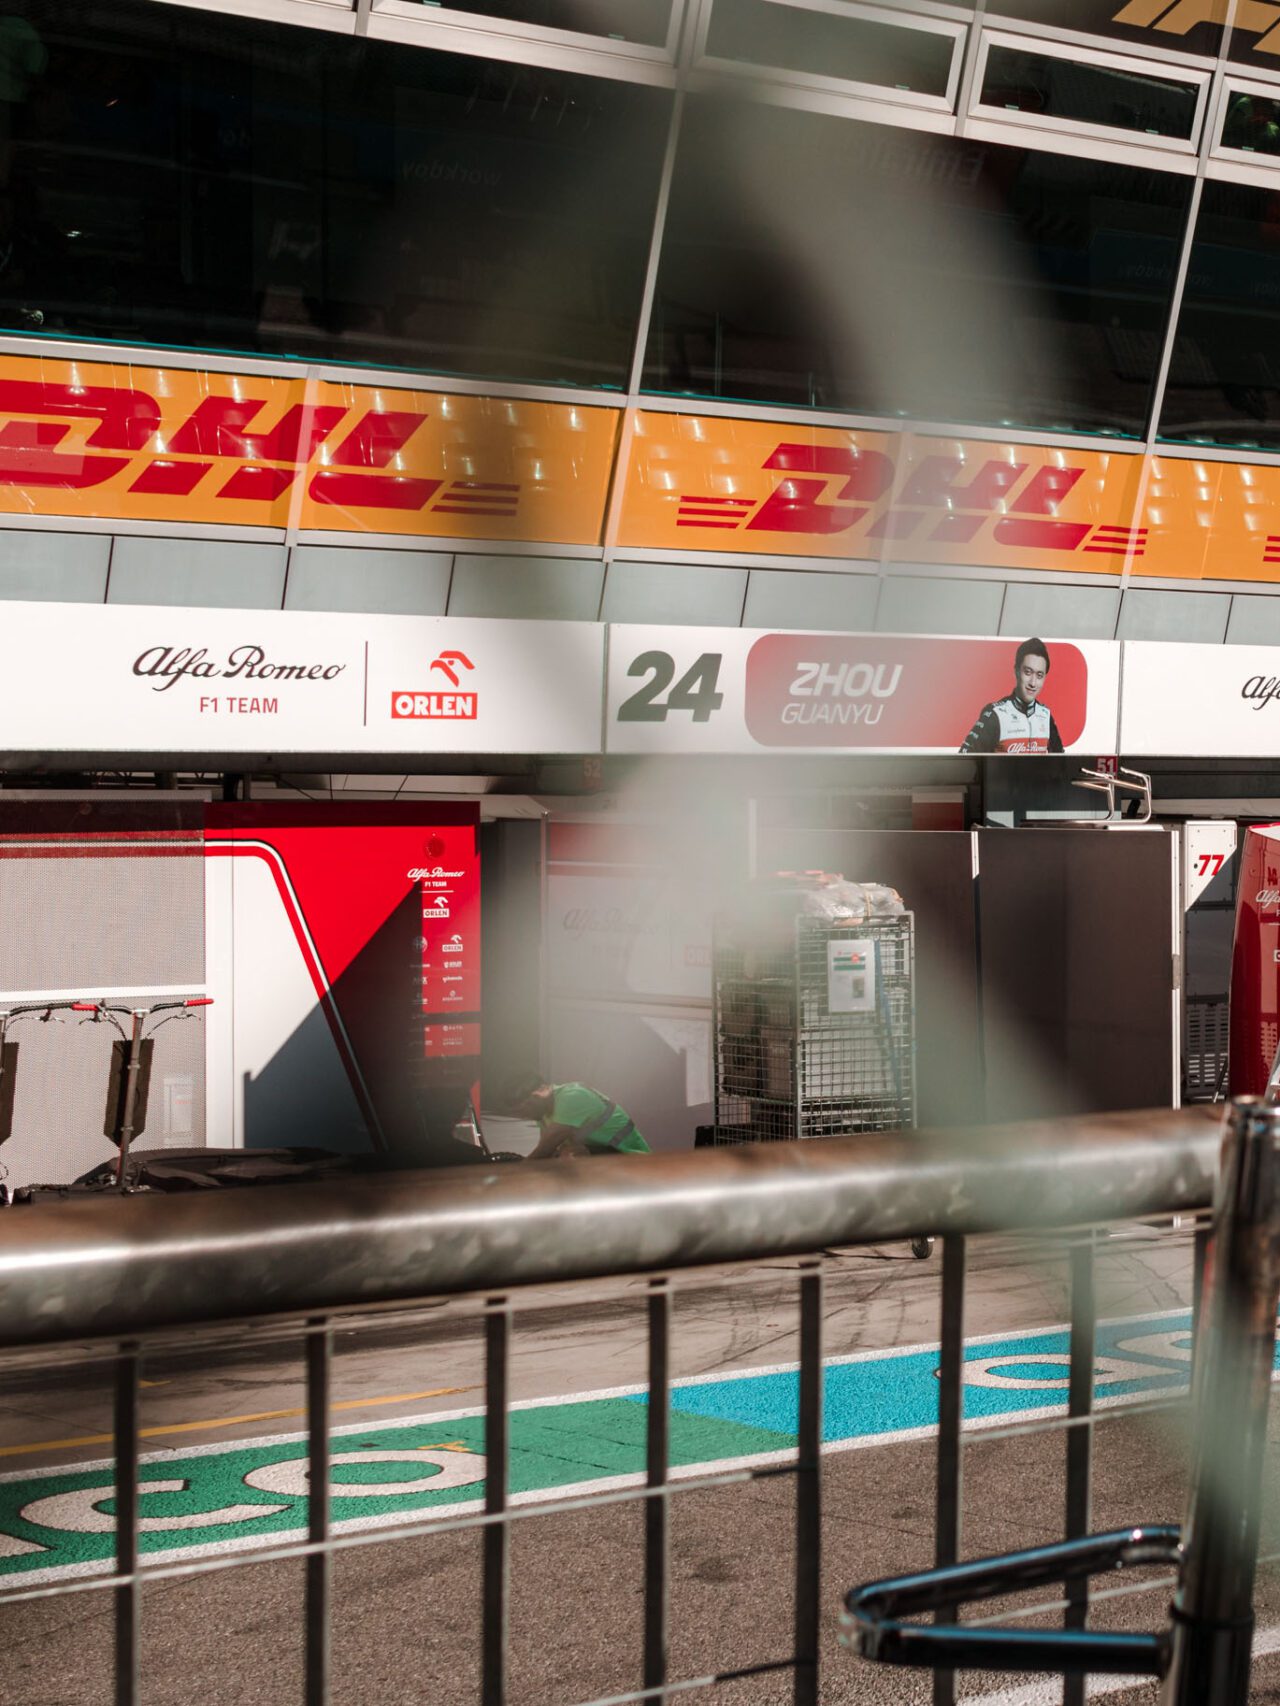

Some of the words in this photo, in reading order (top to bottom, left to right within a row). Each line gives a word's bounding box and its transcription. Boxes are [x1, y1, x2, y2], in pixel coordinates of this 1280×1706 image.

[745, 443, 1086, 551] DHL
[132, 645, 221, 692] Alfa
[222, 645, 346, 680] Romeo
[789, 661, 903, 698] ZHOU
[616, 650, 724, 723] 24
[200, 697, 218, 713] F1
[227, 698, 278, 714] TEAM
[395, 694, 473, 717] ORLEN
[781, 703, 885, 726] GUANYU
[1097, 758, 1115, 775] 51
[407, 867, 430, 882] Alfa
[431, 867, 465, 877] Romeo
[1198, 854, 1225, 877] 77
[425, 909, 448, 917] ORLEN
